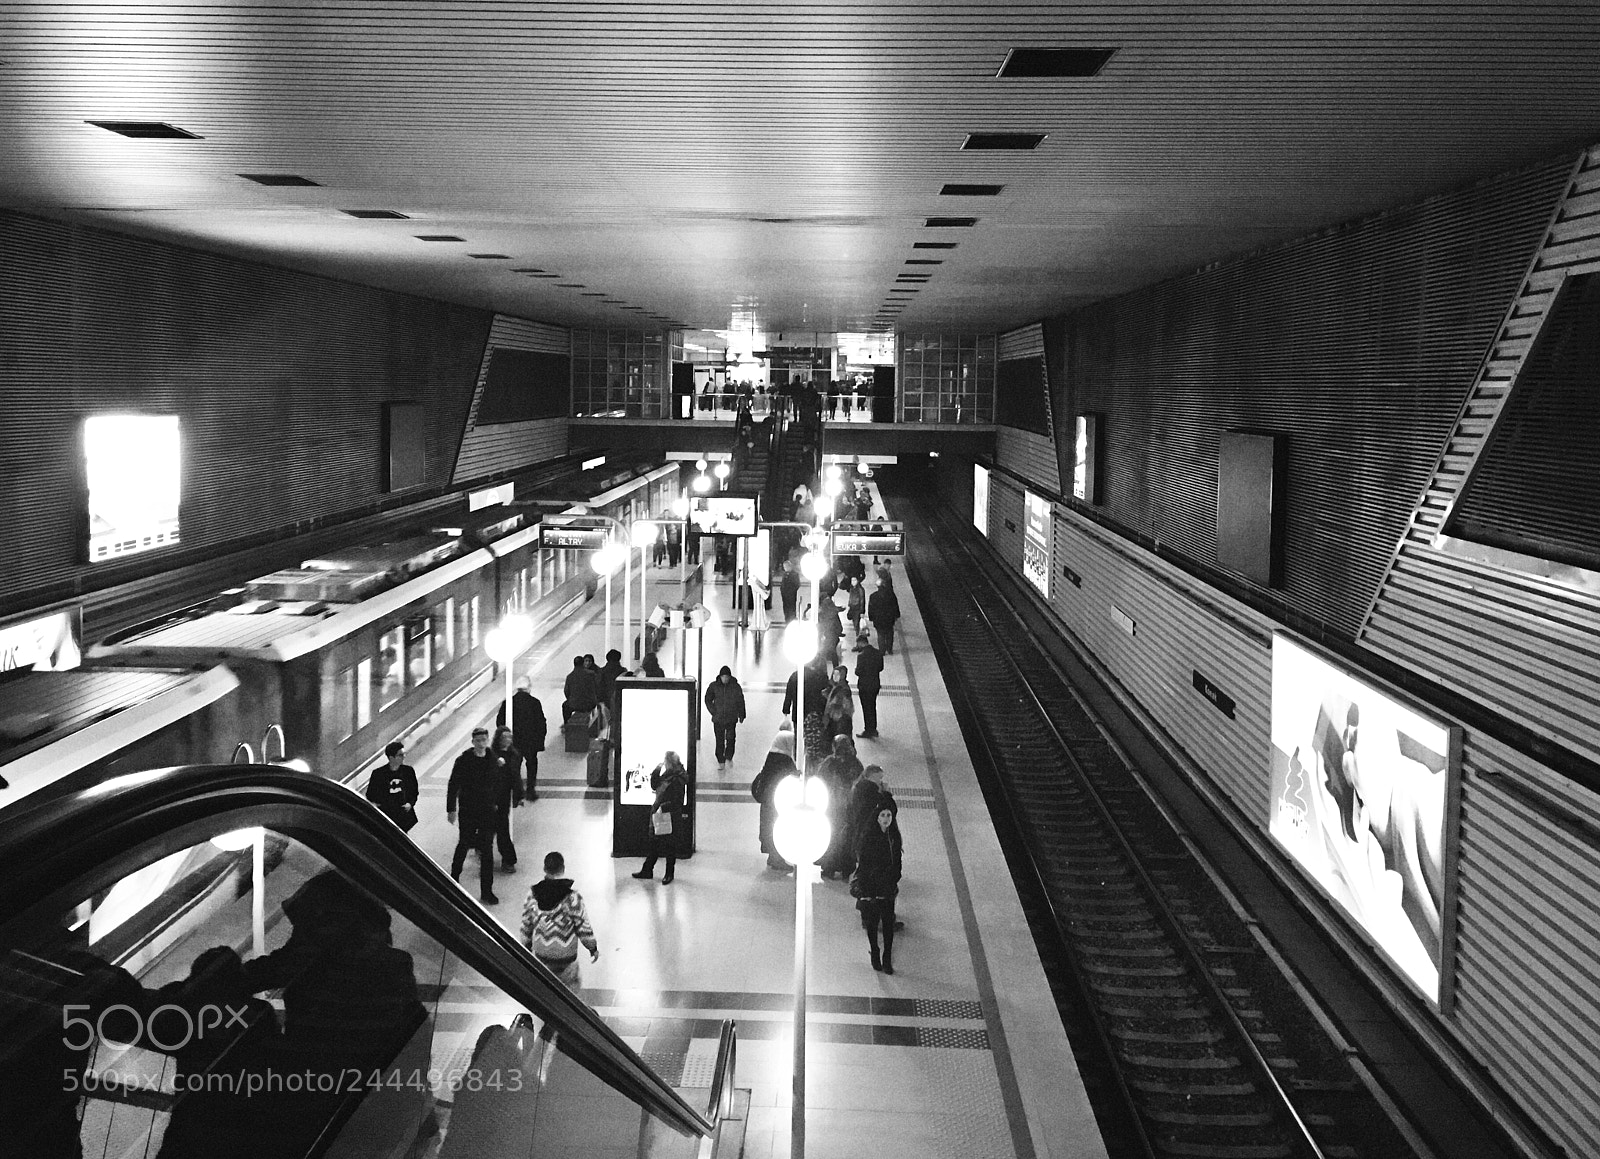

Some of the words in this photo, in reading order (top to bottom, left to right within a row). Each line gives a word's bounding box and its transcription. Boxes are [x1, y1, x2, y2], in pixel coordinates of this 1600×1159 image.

[558, 538, 583, 546] ALTAY
[861, 543, 867, 551] 3
[895, 544, 901, 552] 6
